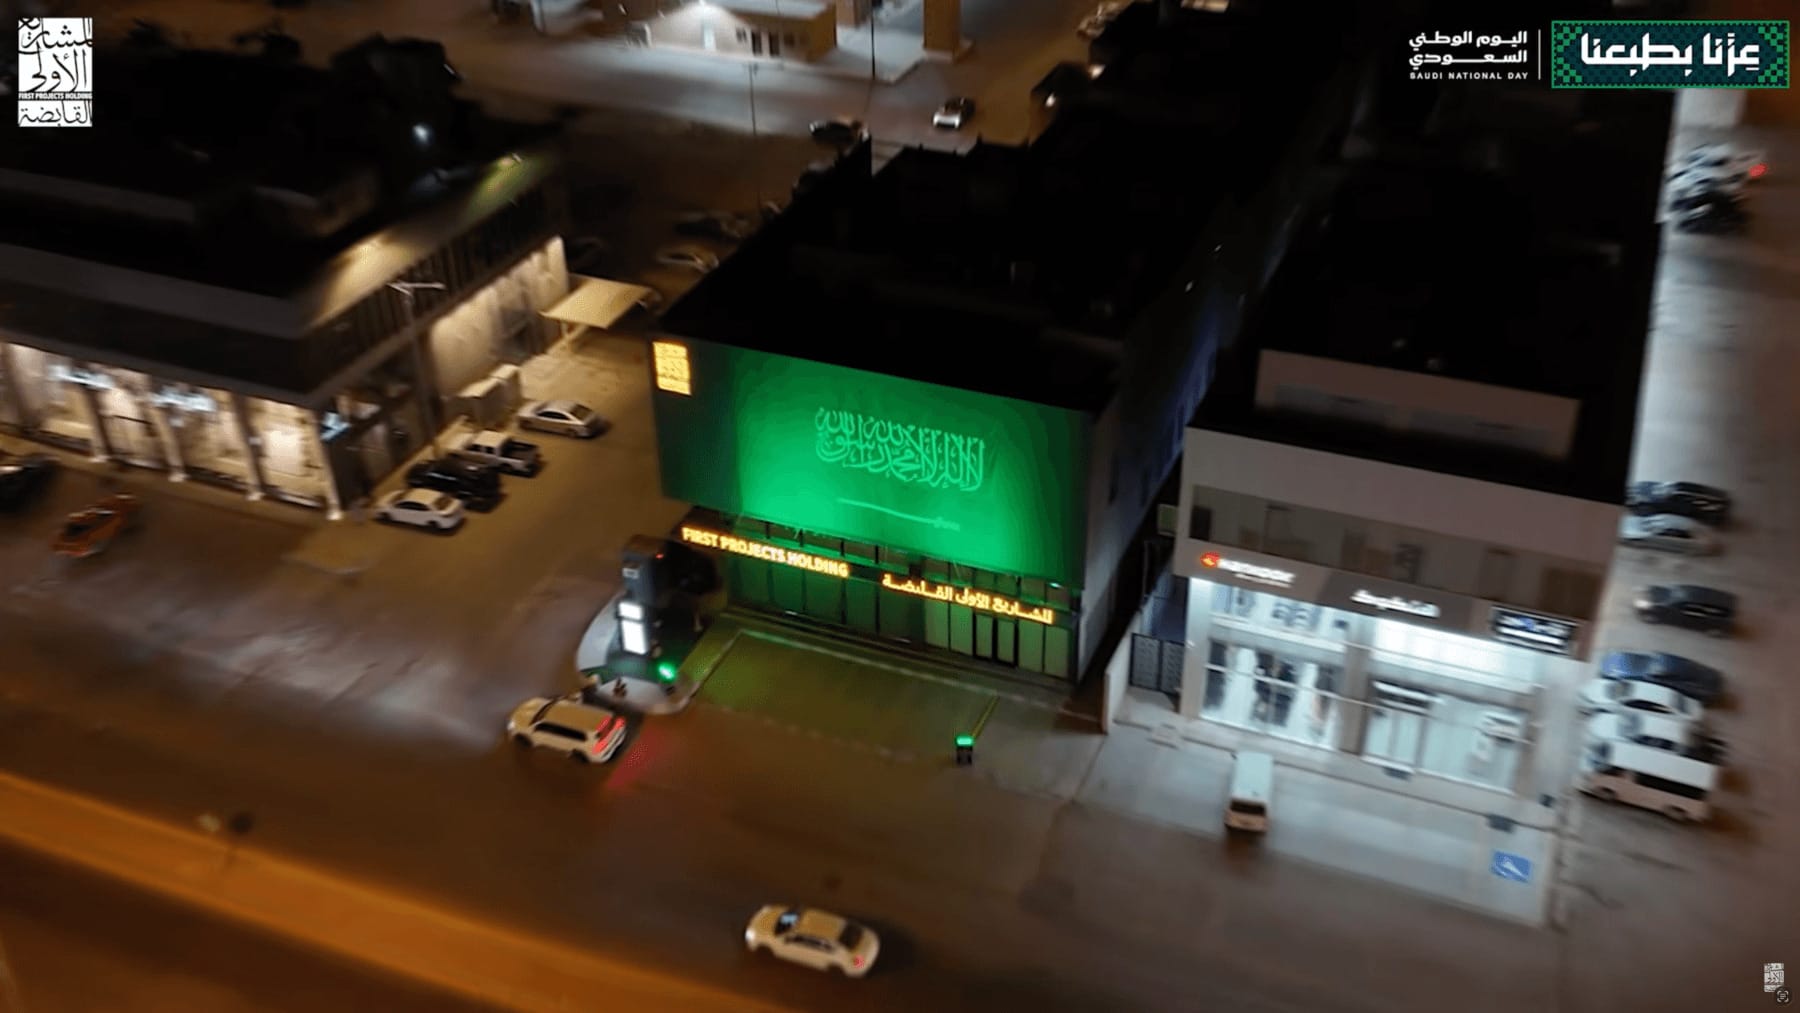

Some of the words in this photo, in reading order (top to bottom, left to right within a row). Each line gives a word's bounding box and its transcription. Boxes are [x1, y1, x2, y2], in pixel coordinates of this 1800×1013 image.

[681, 527, 718, 549] FIRST
[719, 535, 787, 563] PROJECTS
[787, 552, 849, 578] HOLDING
